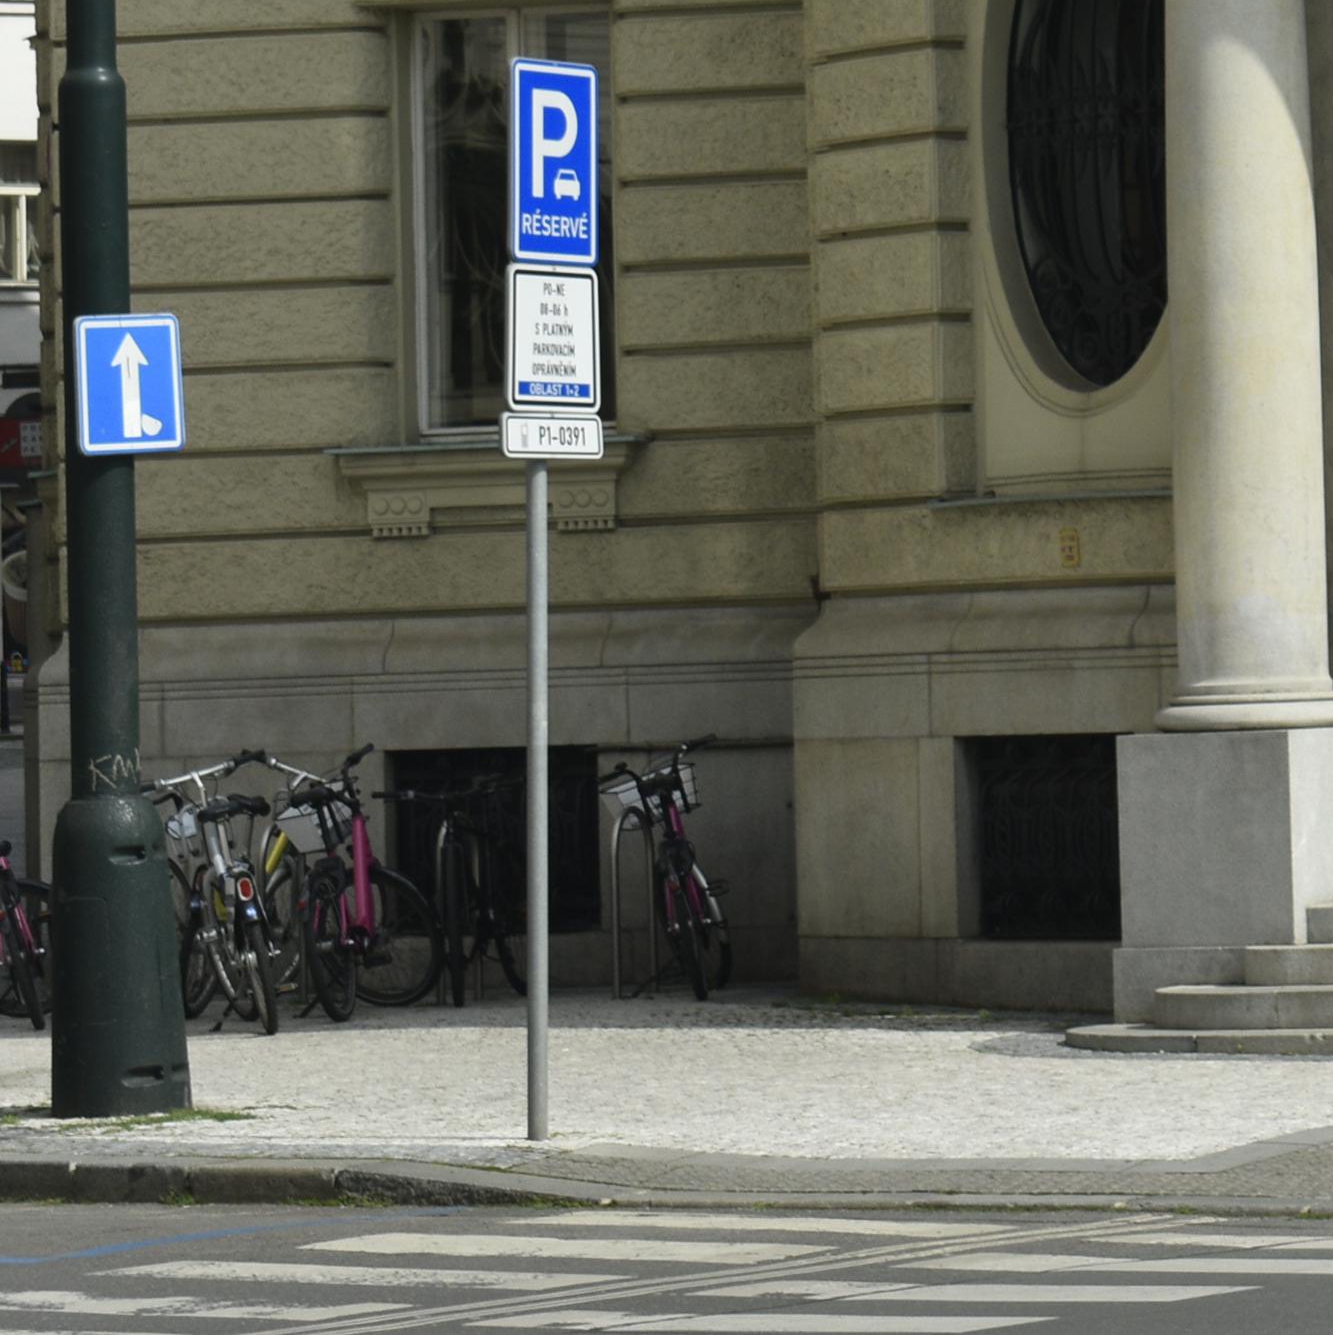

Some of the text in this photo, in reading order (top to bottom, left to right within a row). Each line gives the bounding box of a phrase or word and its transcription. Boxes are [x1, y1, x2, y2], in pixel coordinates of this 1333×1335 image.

[532, 89, 579, 198] P
[521, 208, 589, 239] RÉSERVÉ
[543, 282, 565, 296] PO-NE
[563, 306, 568, 316] h
[535, 321, 574, 337] S PLATNÝM
[533, 342, 576, 357] PARKOVACÍM
[529, 382, 562, 395] OBLAST
[539, 426, 586, 446] P1-0391
